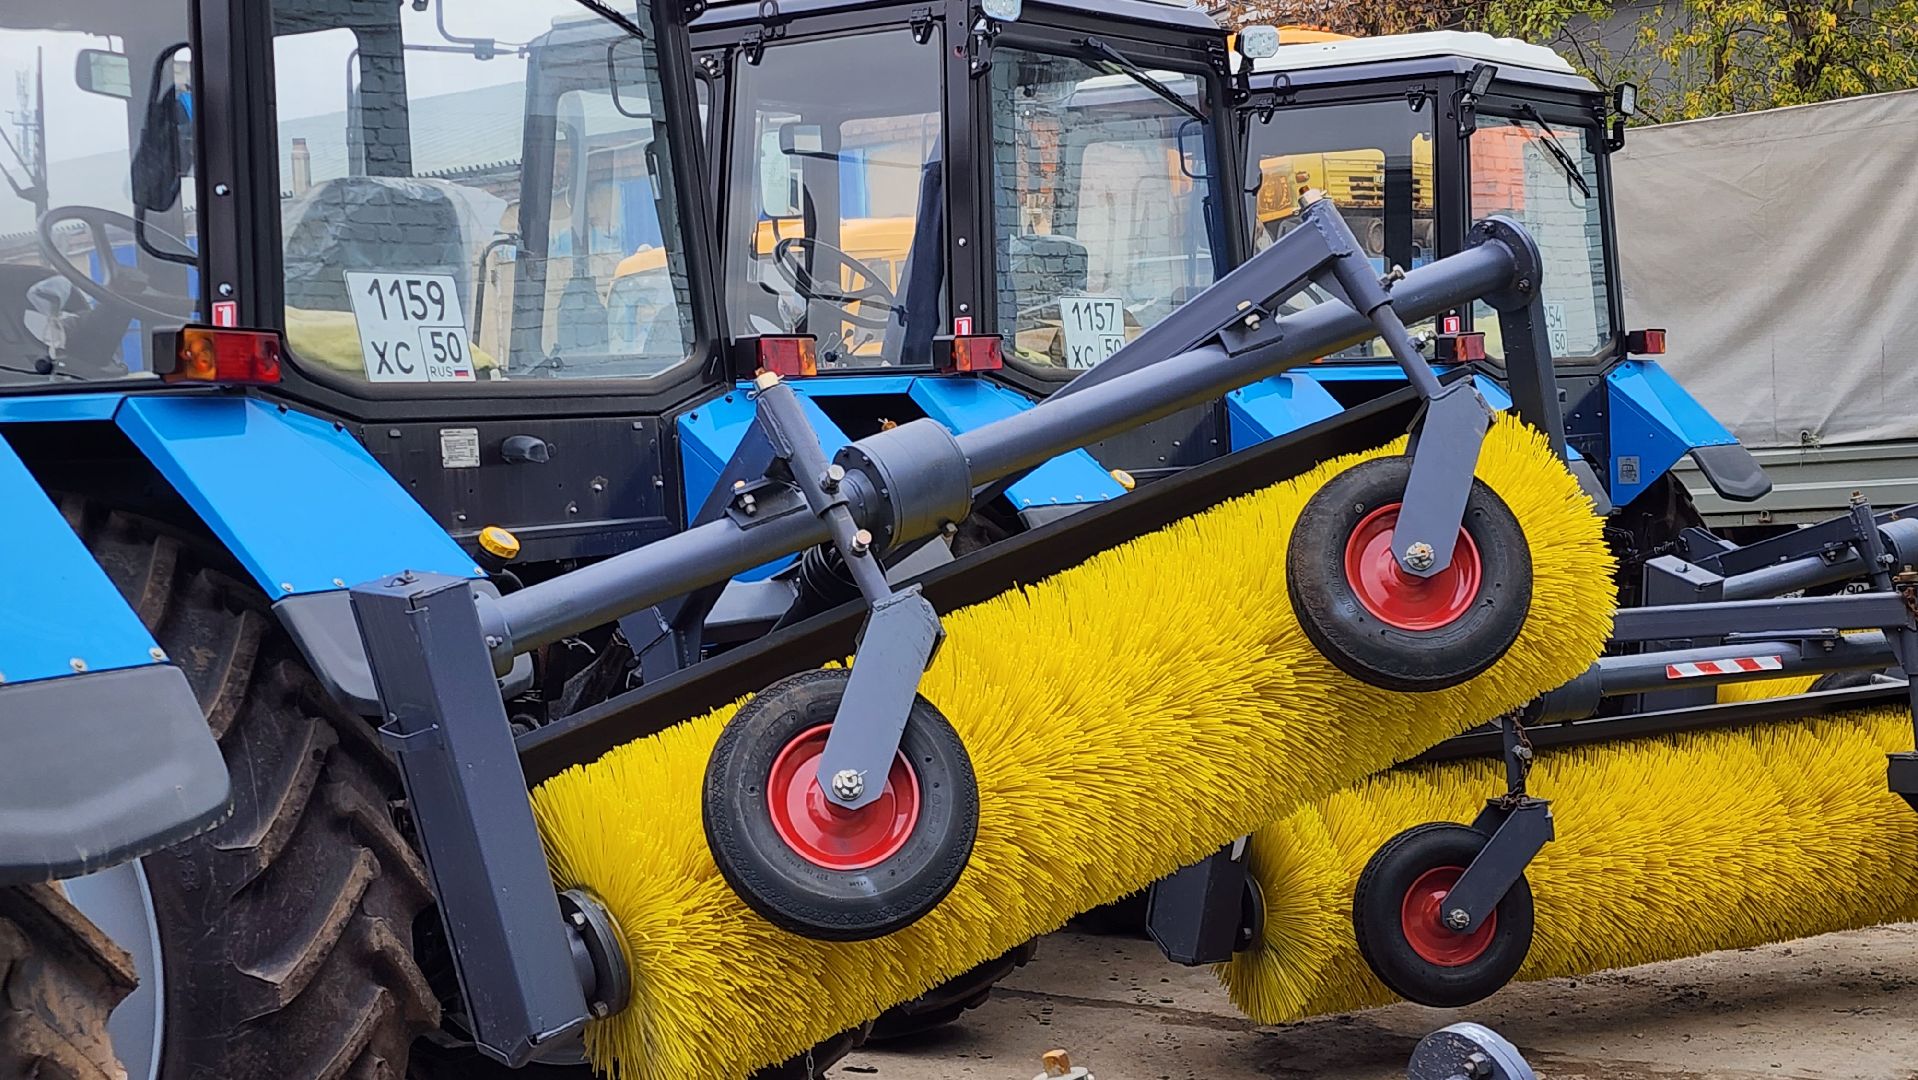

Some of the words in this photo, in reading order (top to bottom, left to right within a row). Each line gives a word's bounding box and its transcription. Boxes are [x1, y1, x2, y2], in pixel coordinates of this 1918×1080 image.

[367, 278, 445, 321] 1159
[1071, 302, 1114, 331] 1157
[371, 341, 415, 375] XC
[430, 331, 462, 363] 50
[1555, 333, 1566, 350] 50
[1072, 345, 1095, 368] XC
[430, 365, 453, 377] RUS
